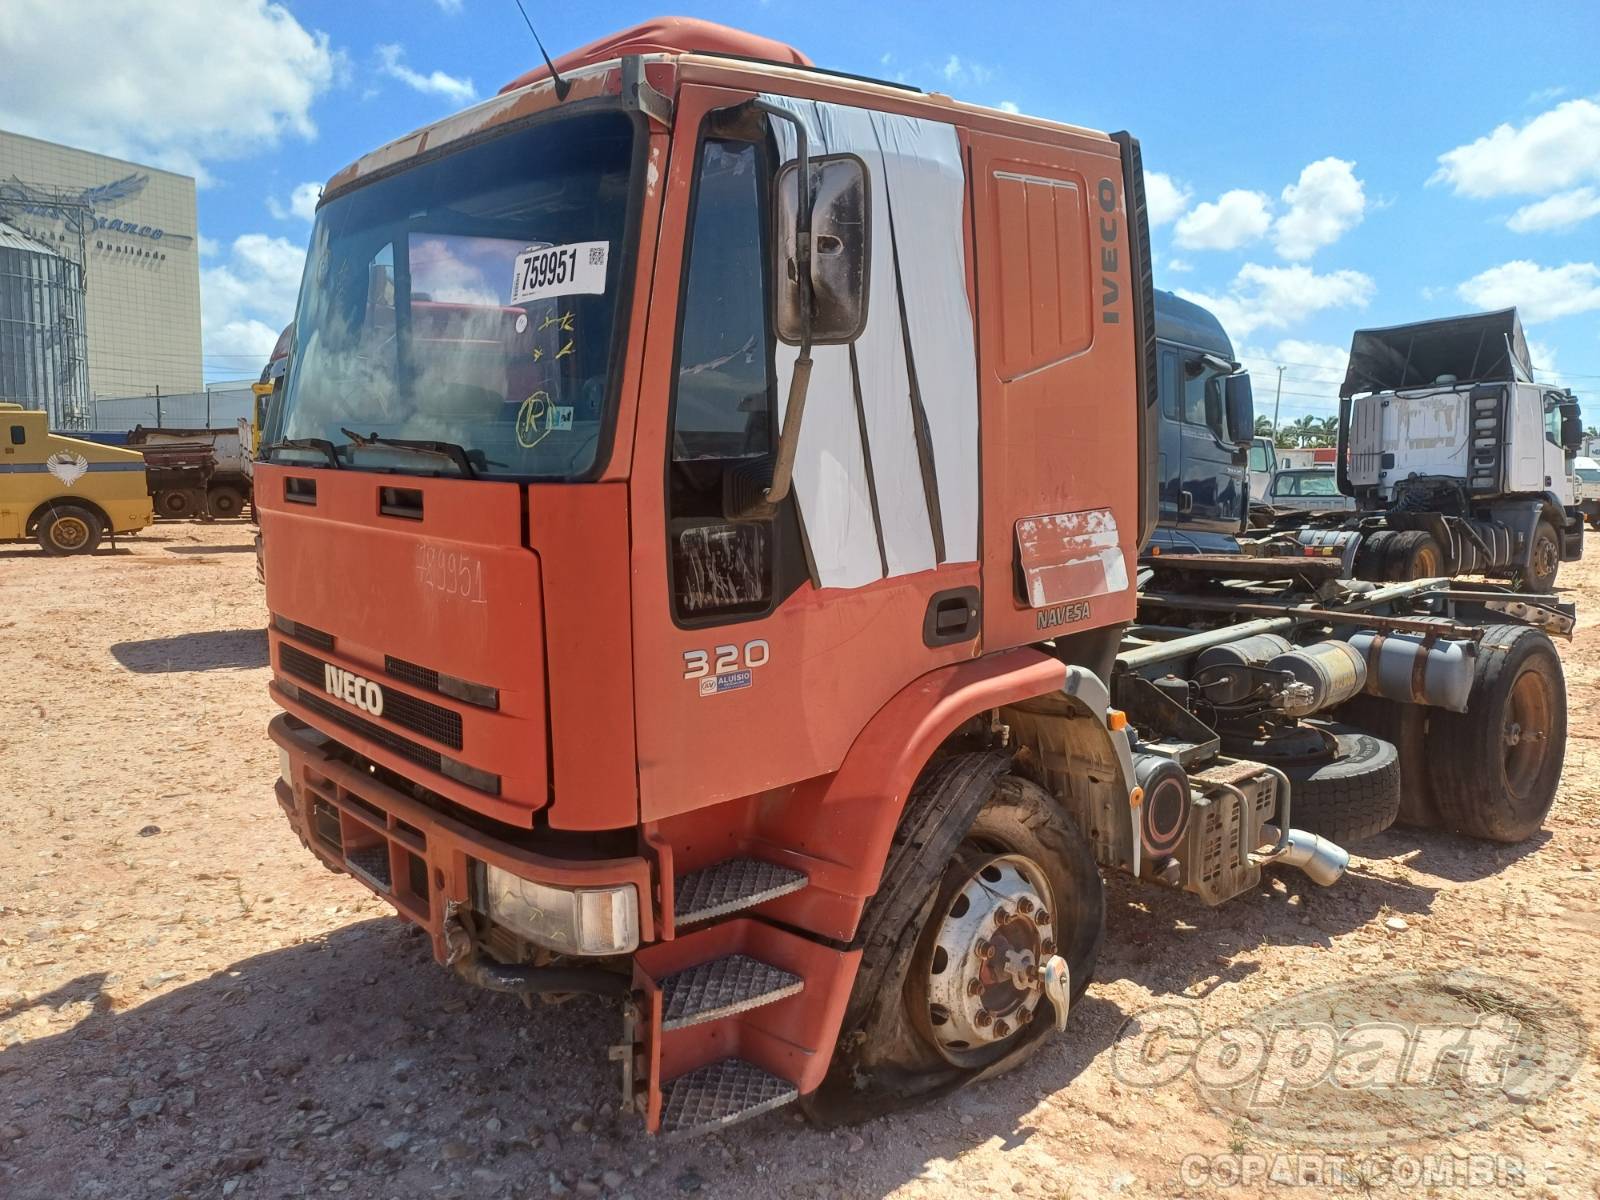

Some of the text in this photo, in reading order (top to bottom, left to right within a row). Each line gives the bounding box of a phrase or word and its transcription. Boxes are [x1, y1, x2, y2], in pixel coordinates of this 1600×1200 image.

[96, 240, 166, 261] Qualidade
[522, 248, 577, 291] 759951
[1097, 177, 1120, 324] IVECO
[1036, 601, 1092, 630] NAVESA
[683, 639, 770, 680] 320
[717, 672, 750, 685] ALUISIO
[324, 662, 384, 717] IVECO
